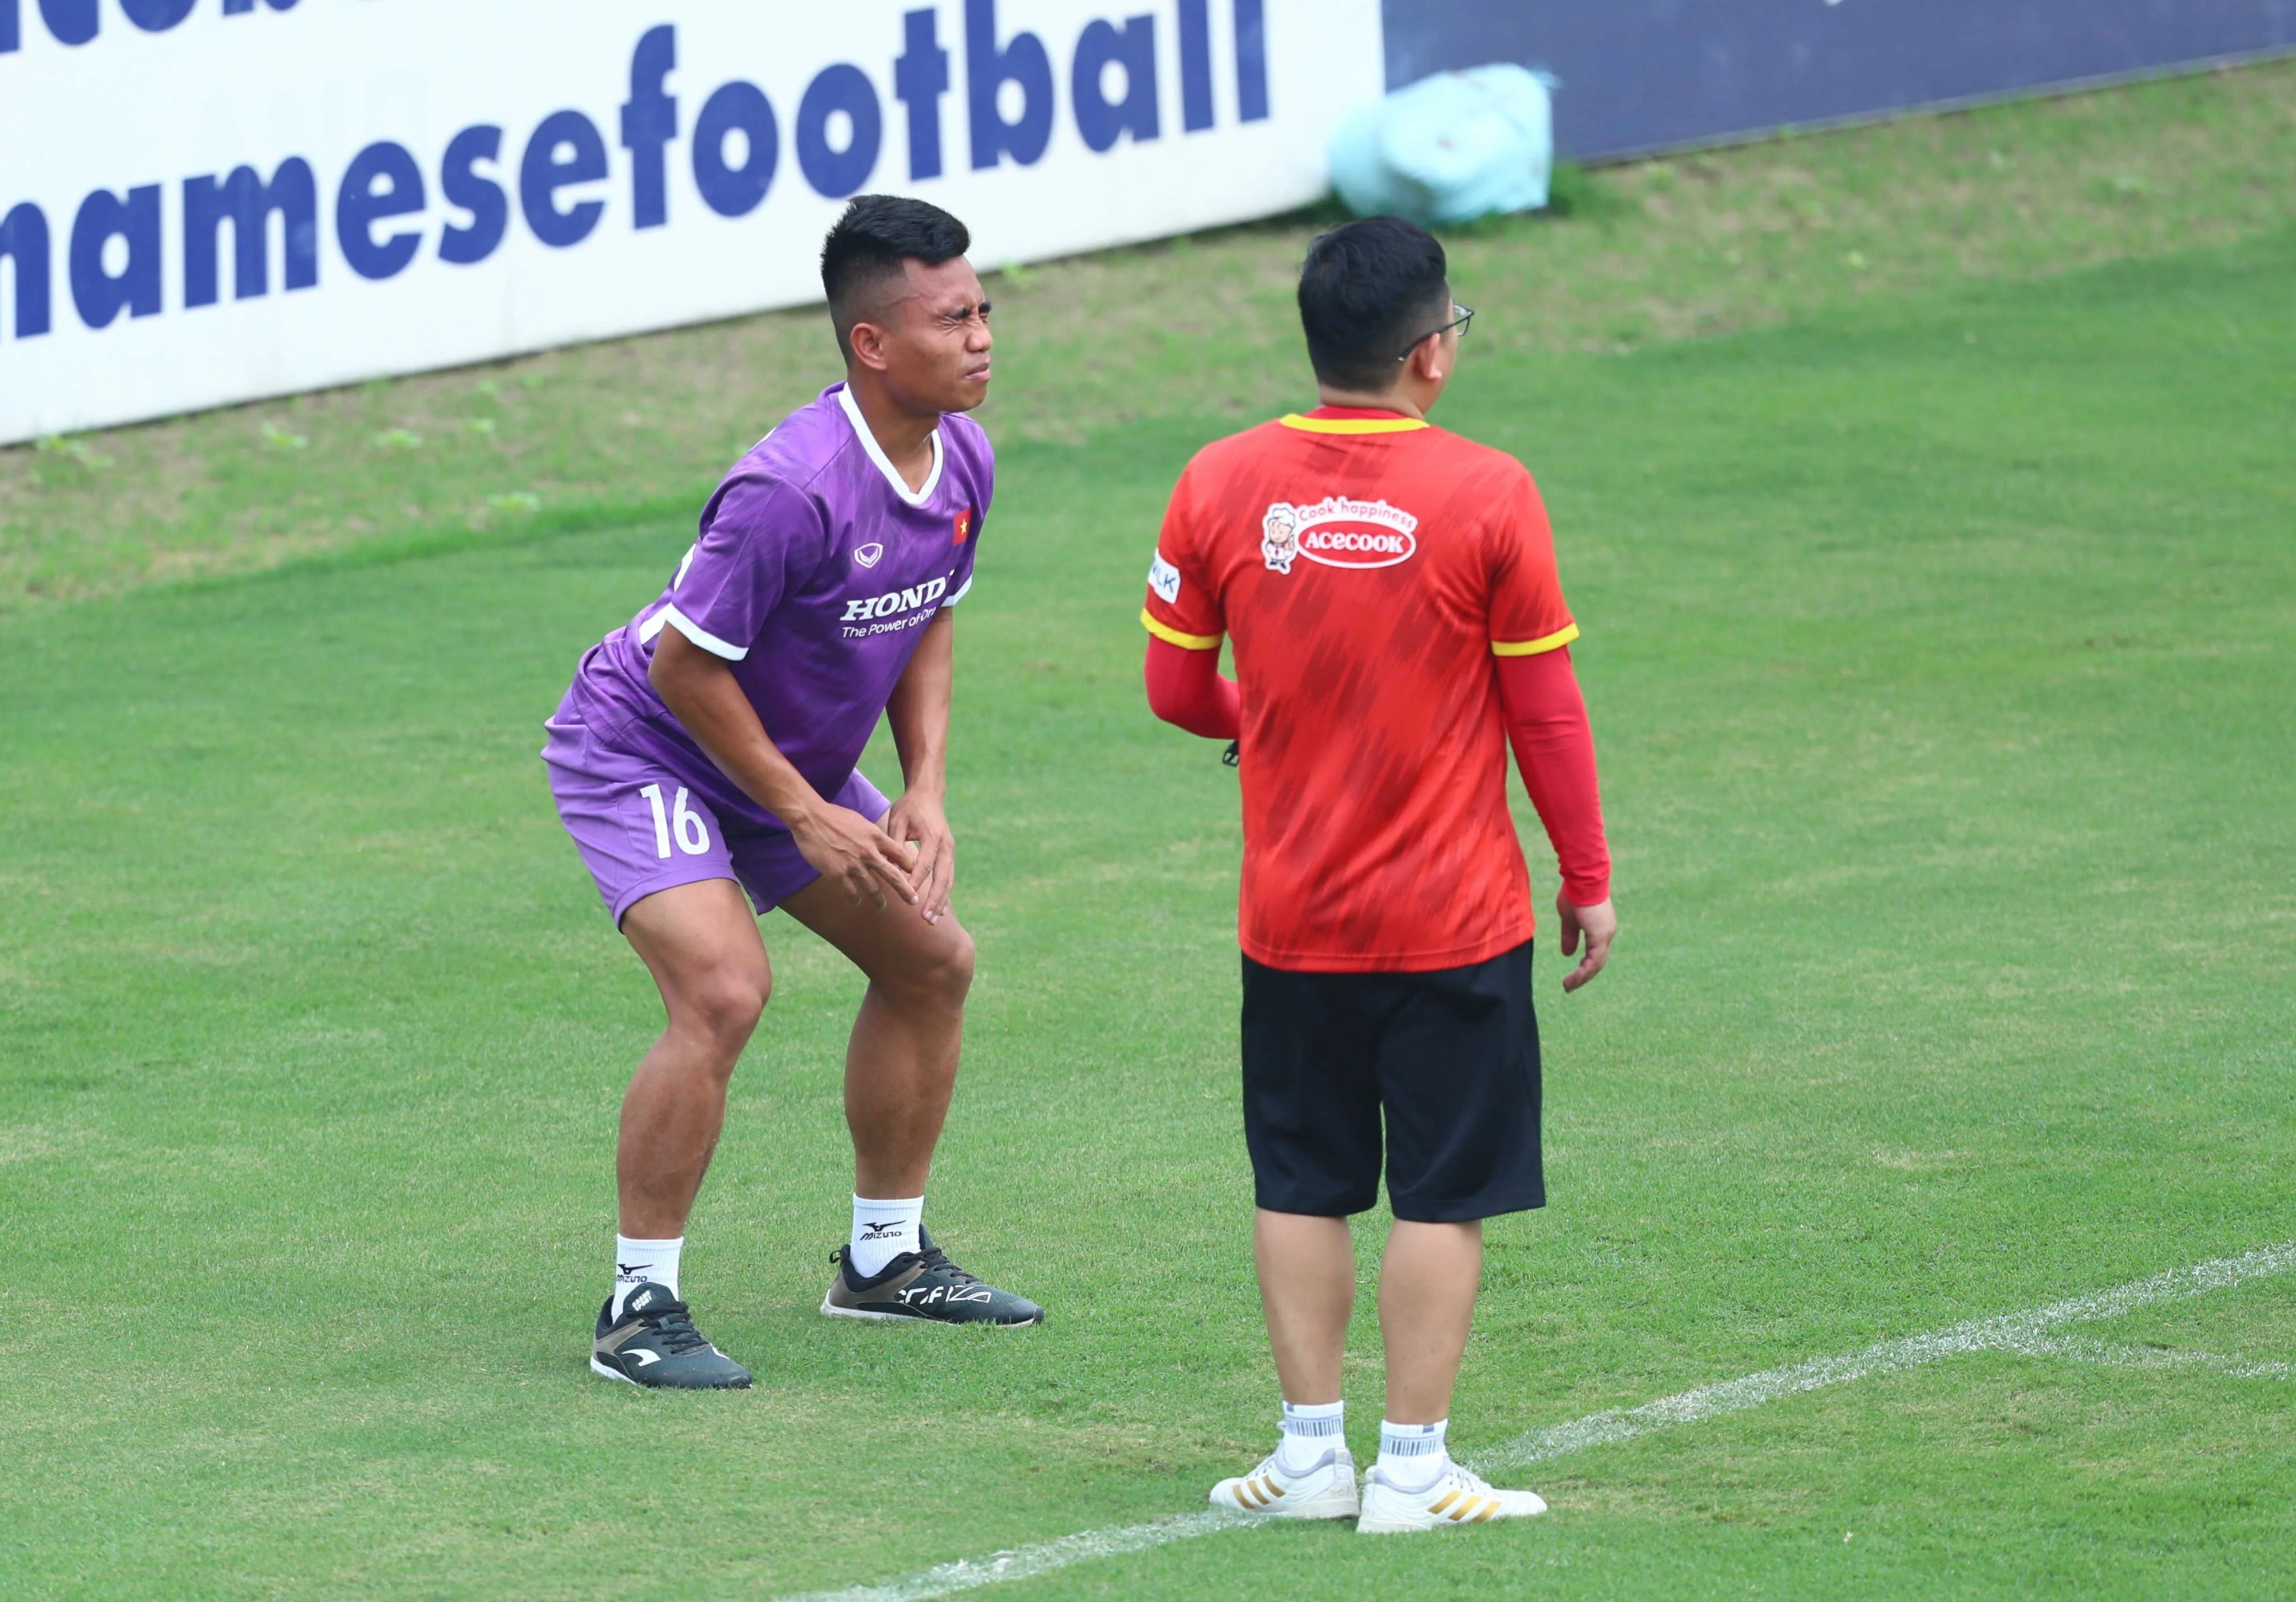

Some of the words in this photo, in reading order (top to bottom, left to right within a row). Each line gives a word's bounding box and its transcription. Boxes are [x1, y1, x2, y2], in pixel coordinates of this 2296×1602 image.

[1299, 501, 1335, 521] Cook
[1341, 500, 1414, 529] happiness
[840, 569, 955, 621] HOND
[842, 627, 866, 638] The
[868, 619, 908, 636] Power
[908, 612, 921, 627] of
[639, 783, 710, 859] 16
